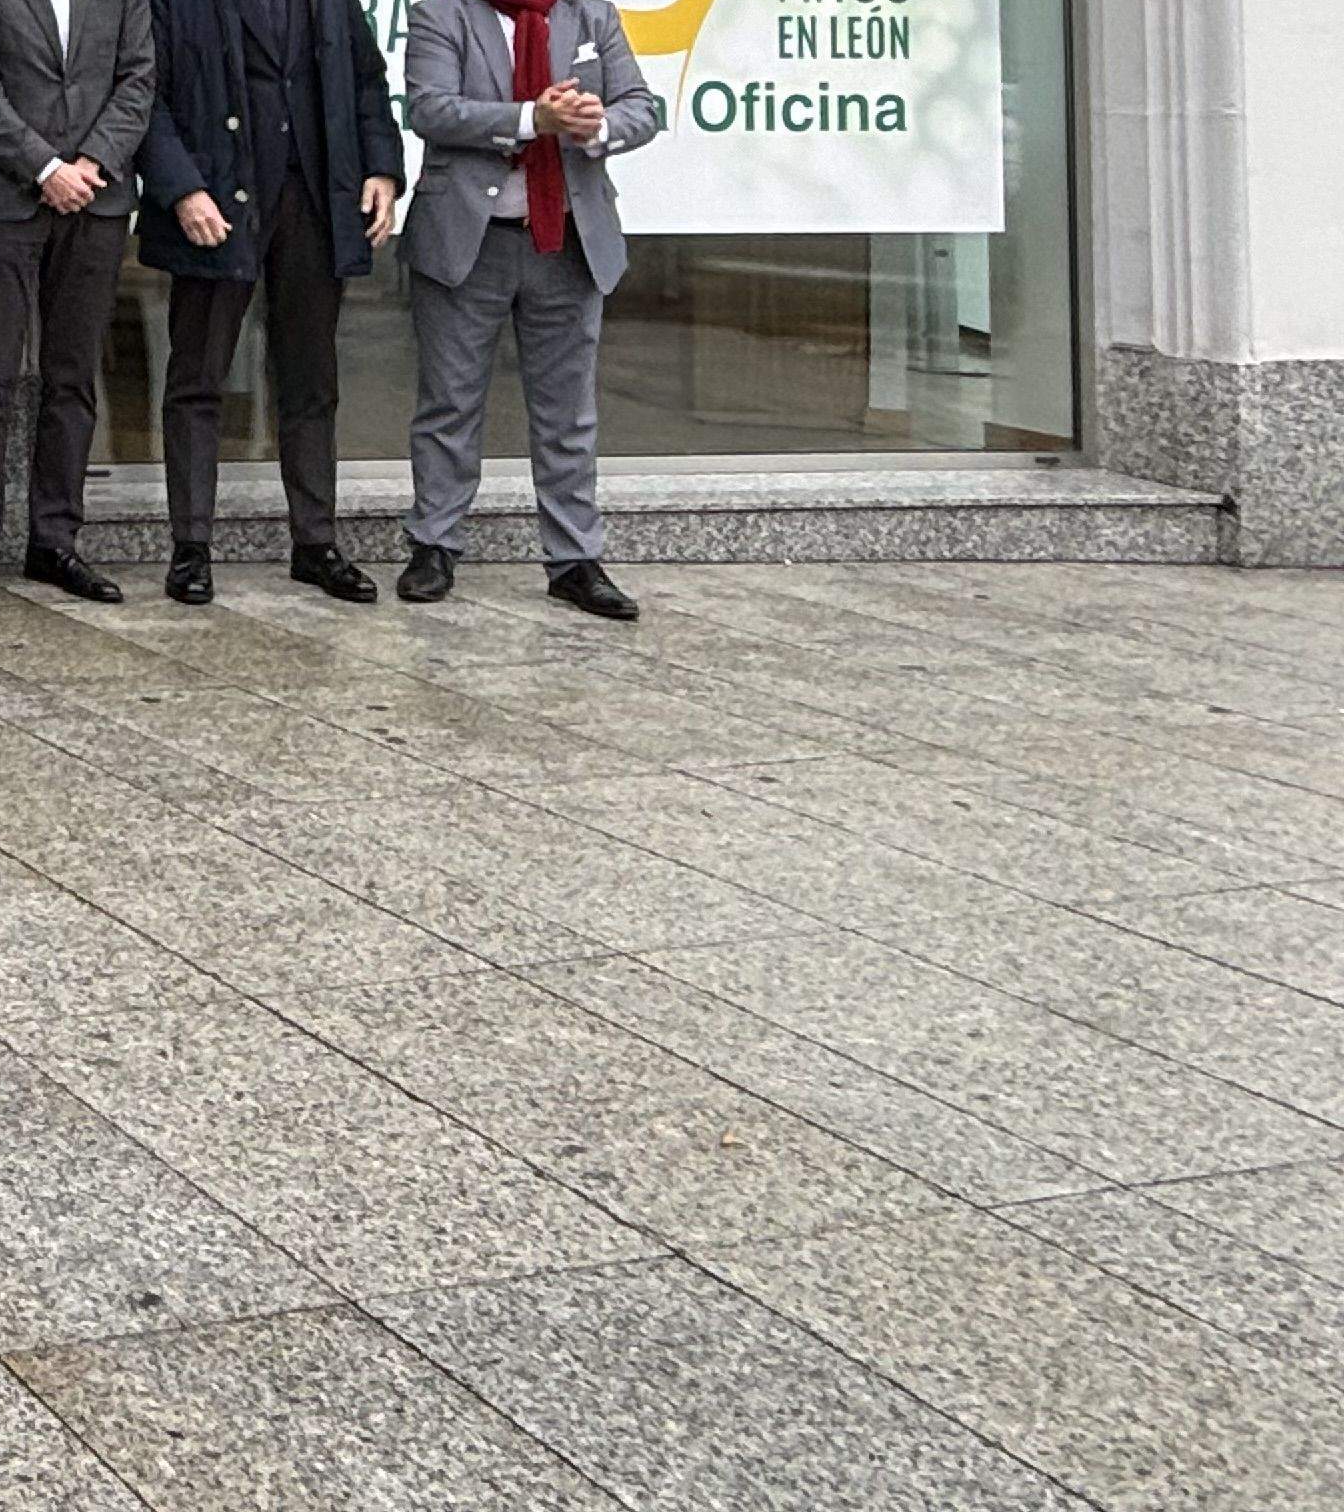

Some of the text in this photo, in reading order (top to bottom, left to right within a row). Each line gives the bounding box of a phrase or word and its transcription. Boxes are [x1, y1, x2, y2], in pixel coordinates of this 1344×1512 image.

[778, 6, 911, 60] EN LEÓN
[690, 80, 908, 133] Oficina
